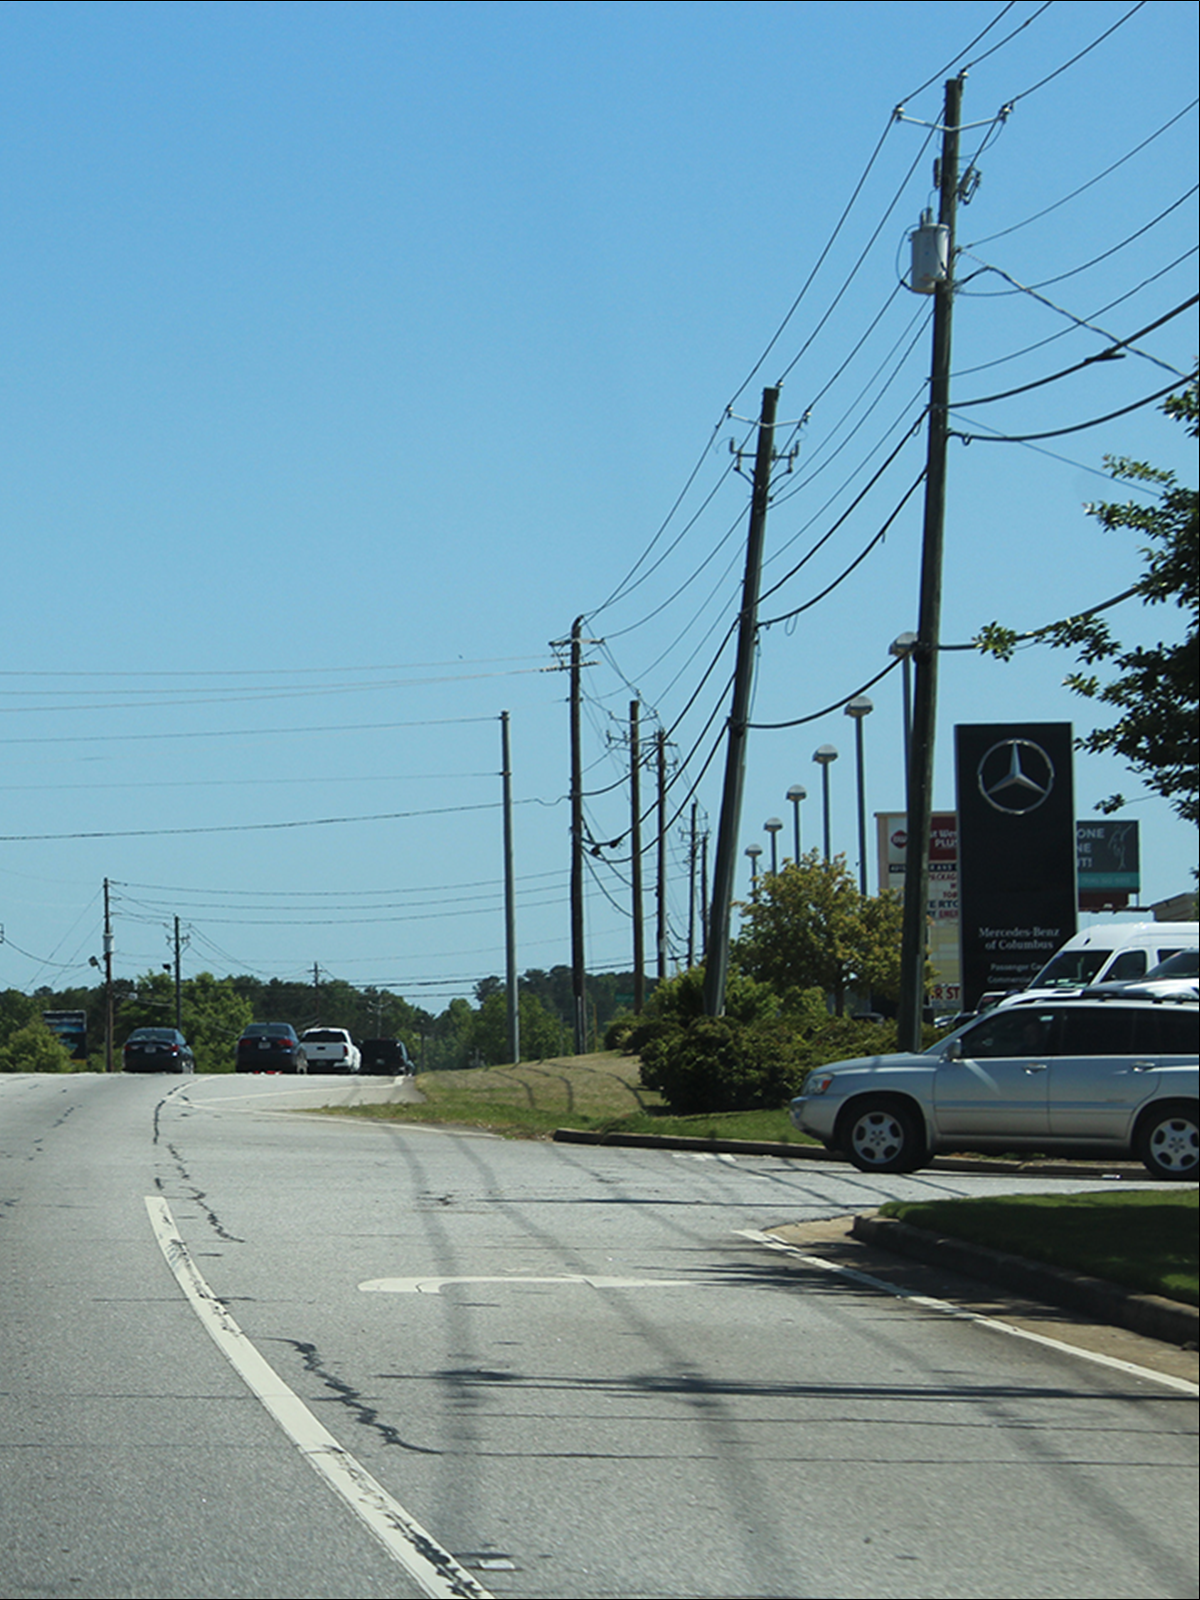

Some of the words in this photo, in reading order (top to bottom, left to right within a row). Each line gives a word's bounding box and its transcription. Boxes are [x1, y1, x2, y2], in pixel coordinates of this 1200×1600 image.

[978, 927, 1060, 937] Mercedes-Benz
[985, 940, 997, 950] of
[998, 940, 1054, 950] Columbus
